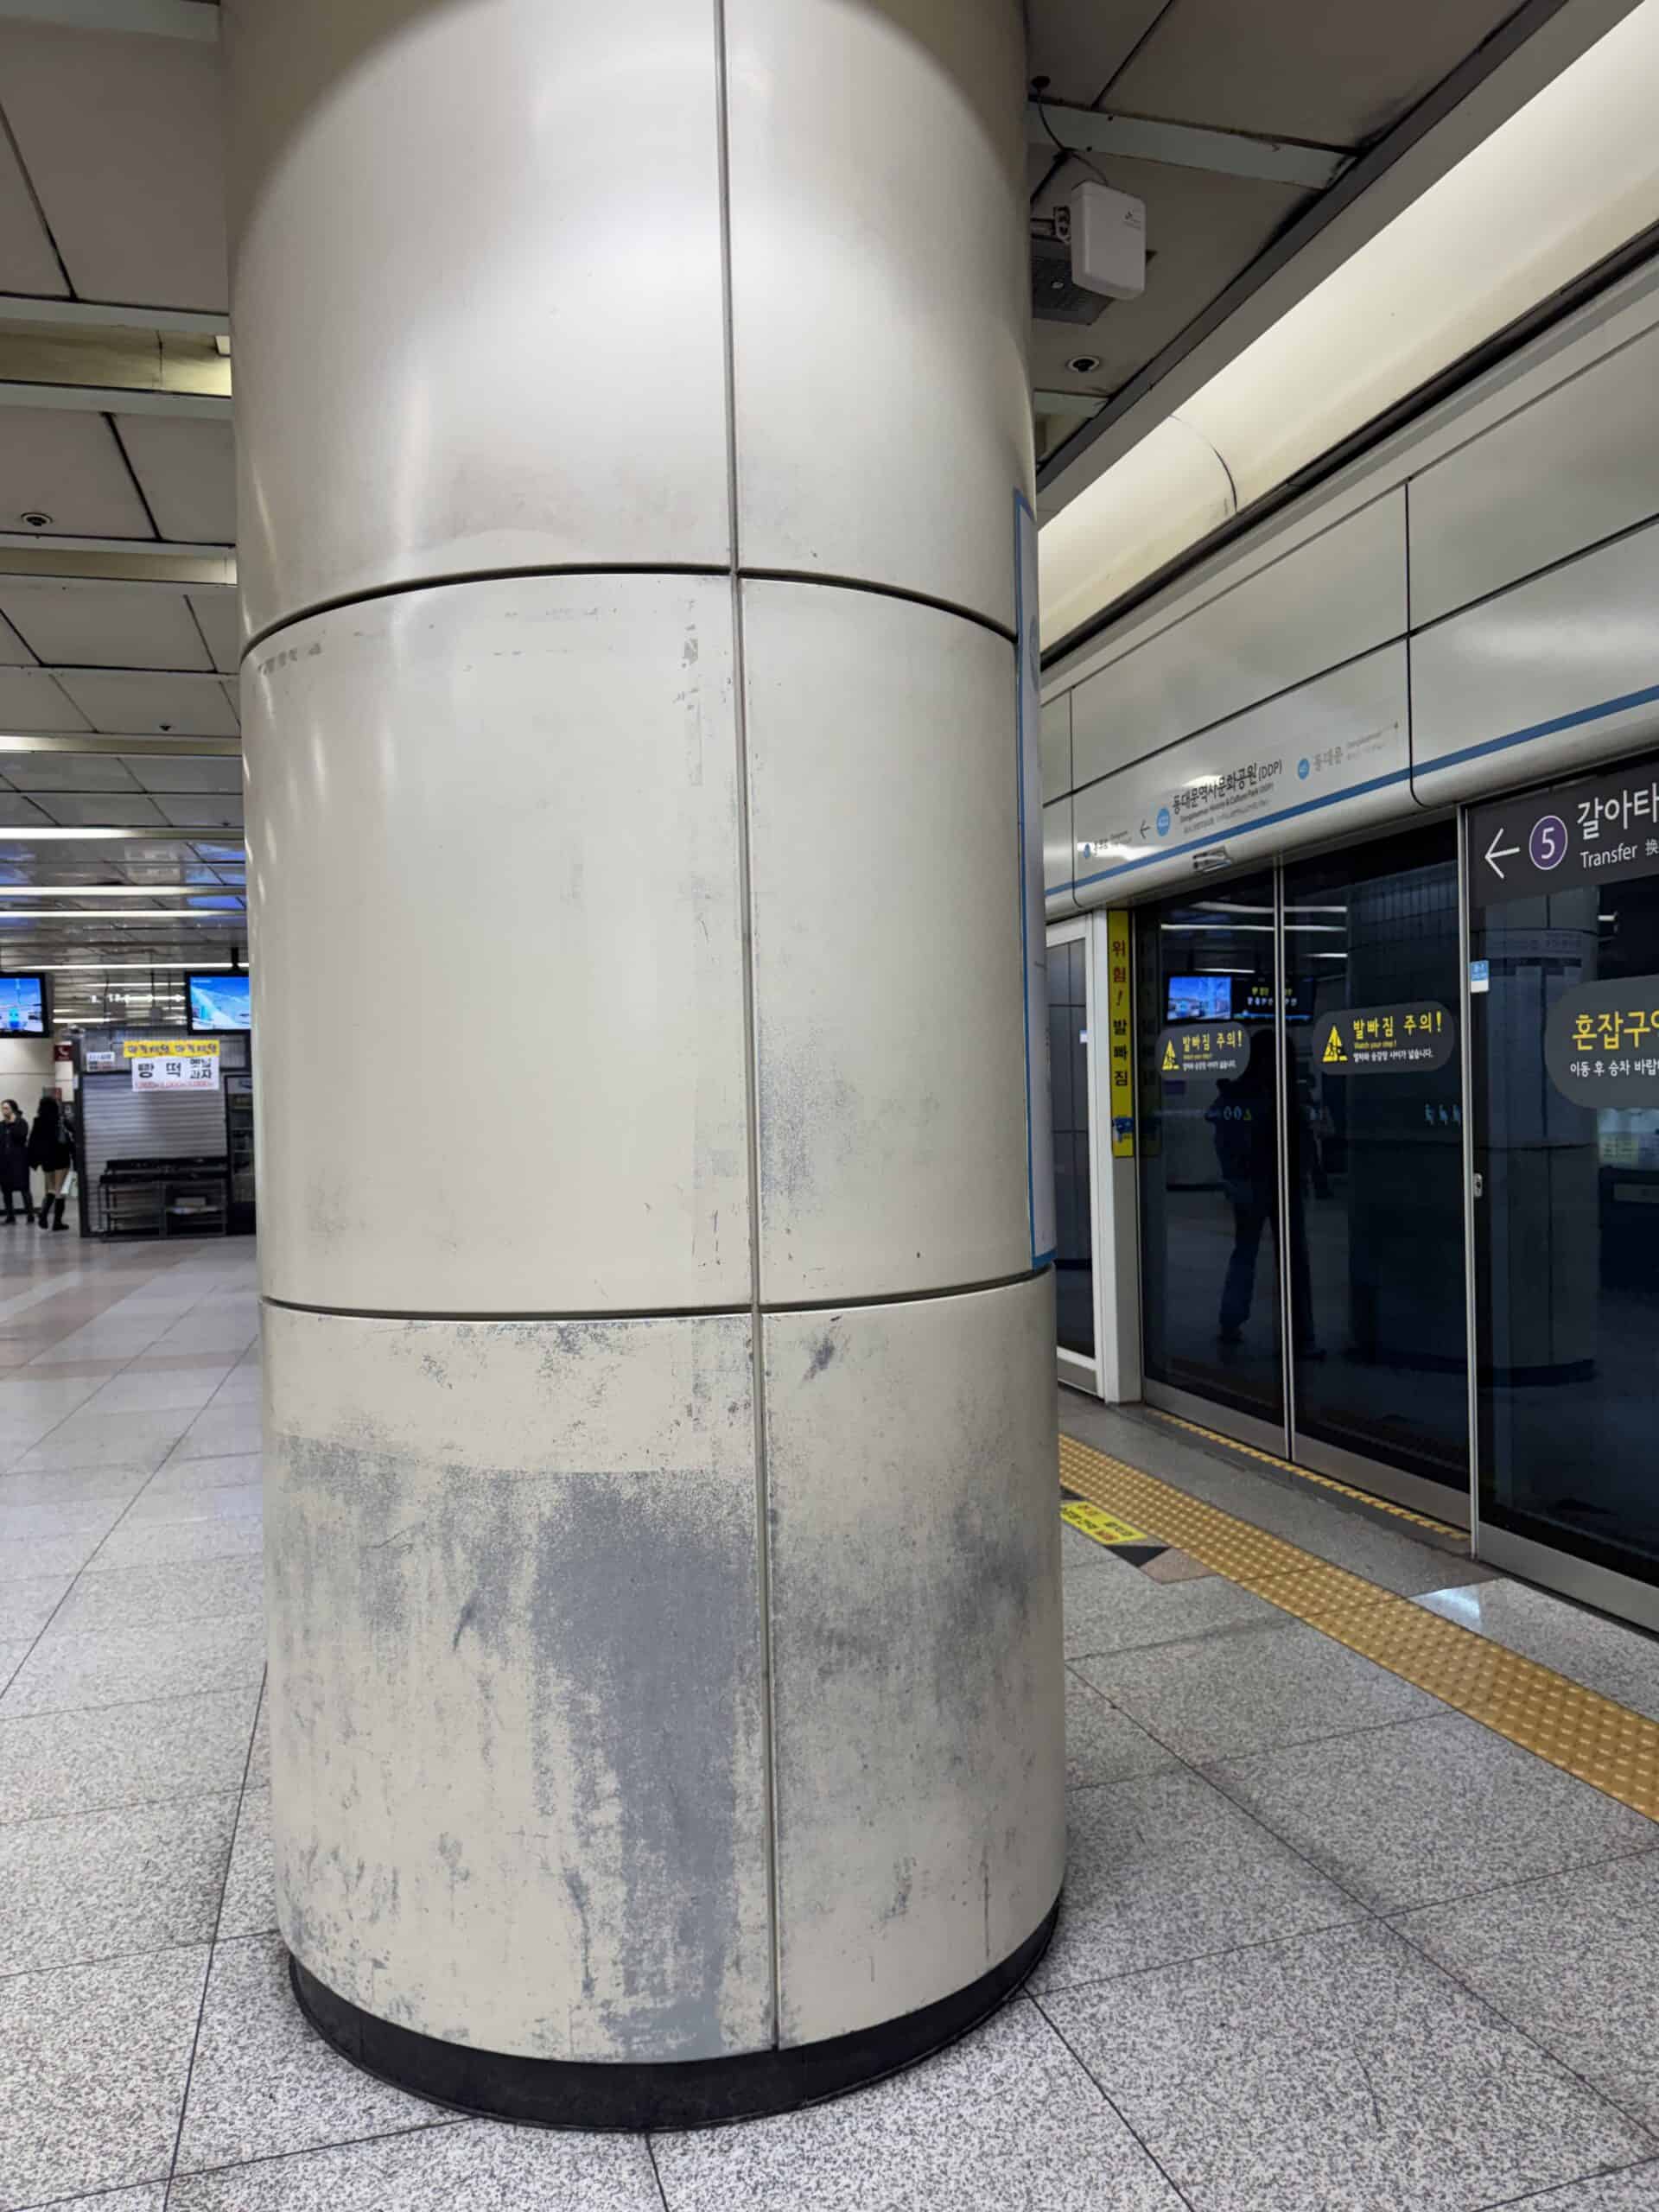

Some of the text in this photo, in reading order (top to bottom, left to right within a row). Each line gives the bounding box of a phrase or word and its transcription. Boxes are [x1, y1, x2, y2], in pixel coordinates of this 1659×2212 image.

[1541, 826, 1555, 860] 5
[1580, 842, 1637, 868] Transfer
[1112, 939, 1127, 1007] 위험!
[1353, 1011, 1442, 1039] 발빠짐 주의!
[1113, 1018, 1128, 1087] 발빠짐
[1217, 1029, 1243, 1050] 주의!
[1569, 1058, 1659, 1077] 이동 후 승차 바랍
